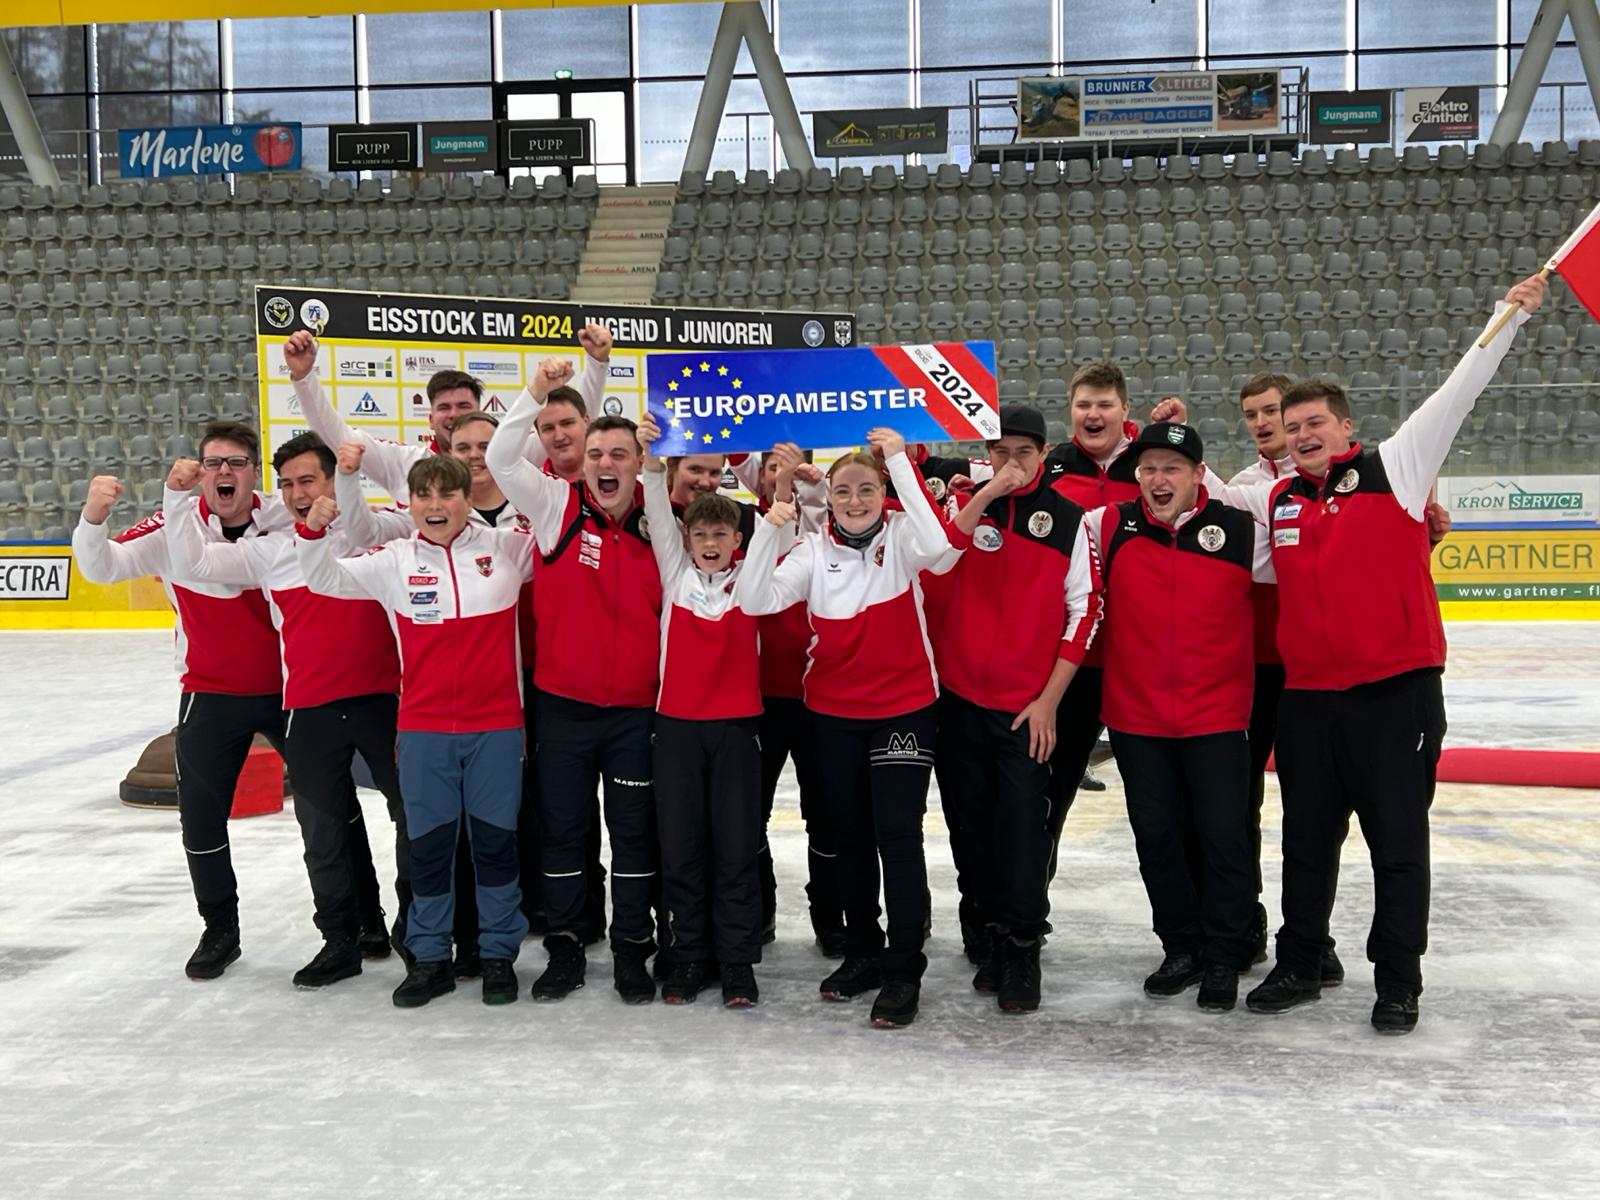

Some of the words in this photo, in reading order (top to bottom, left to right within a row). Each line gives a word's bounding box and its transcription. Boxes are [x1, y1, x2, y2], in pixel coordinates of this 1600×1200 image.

[1087, 79, 1146, 93] BRUNNER
[1167, 79, 1210, 89] LEITER
[1419, 101, 1468, 112] Elektro
[1323, 110, 1378, 122] Jungmann
[356, 143, 390, 155] PUPP
[435, 140, 485, 150] Jungmann
[529, 139, 564, 150] PUPP
[129, 128, 244, 178] Marlene
[367, 307, 477, 336] EISSTOCK
[482, 312, 515, 337] EM
[521, 314, 573, 338] 2024
[678, 320, 773, 345] JUNIOREN
[341, 361, 366, 369] arc
[929, 363, 984, 417] 2024
[674, 387, 928, 418] EUROPAMEISTER
[1457, 496, 1505, 508] KRON
[1511, 495, 1580, 508] SERVICE
[1439, 544, 1593, 569] GARTNER
[1458, 587, 1566, 598] www.gartner
